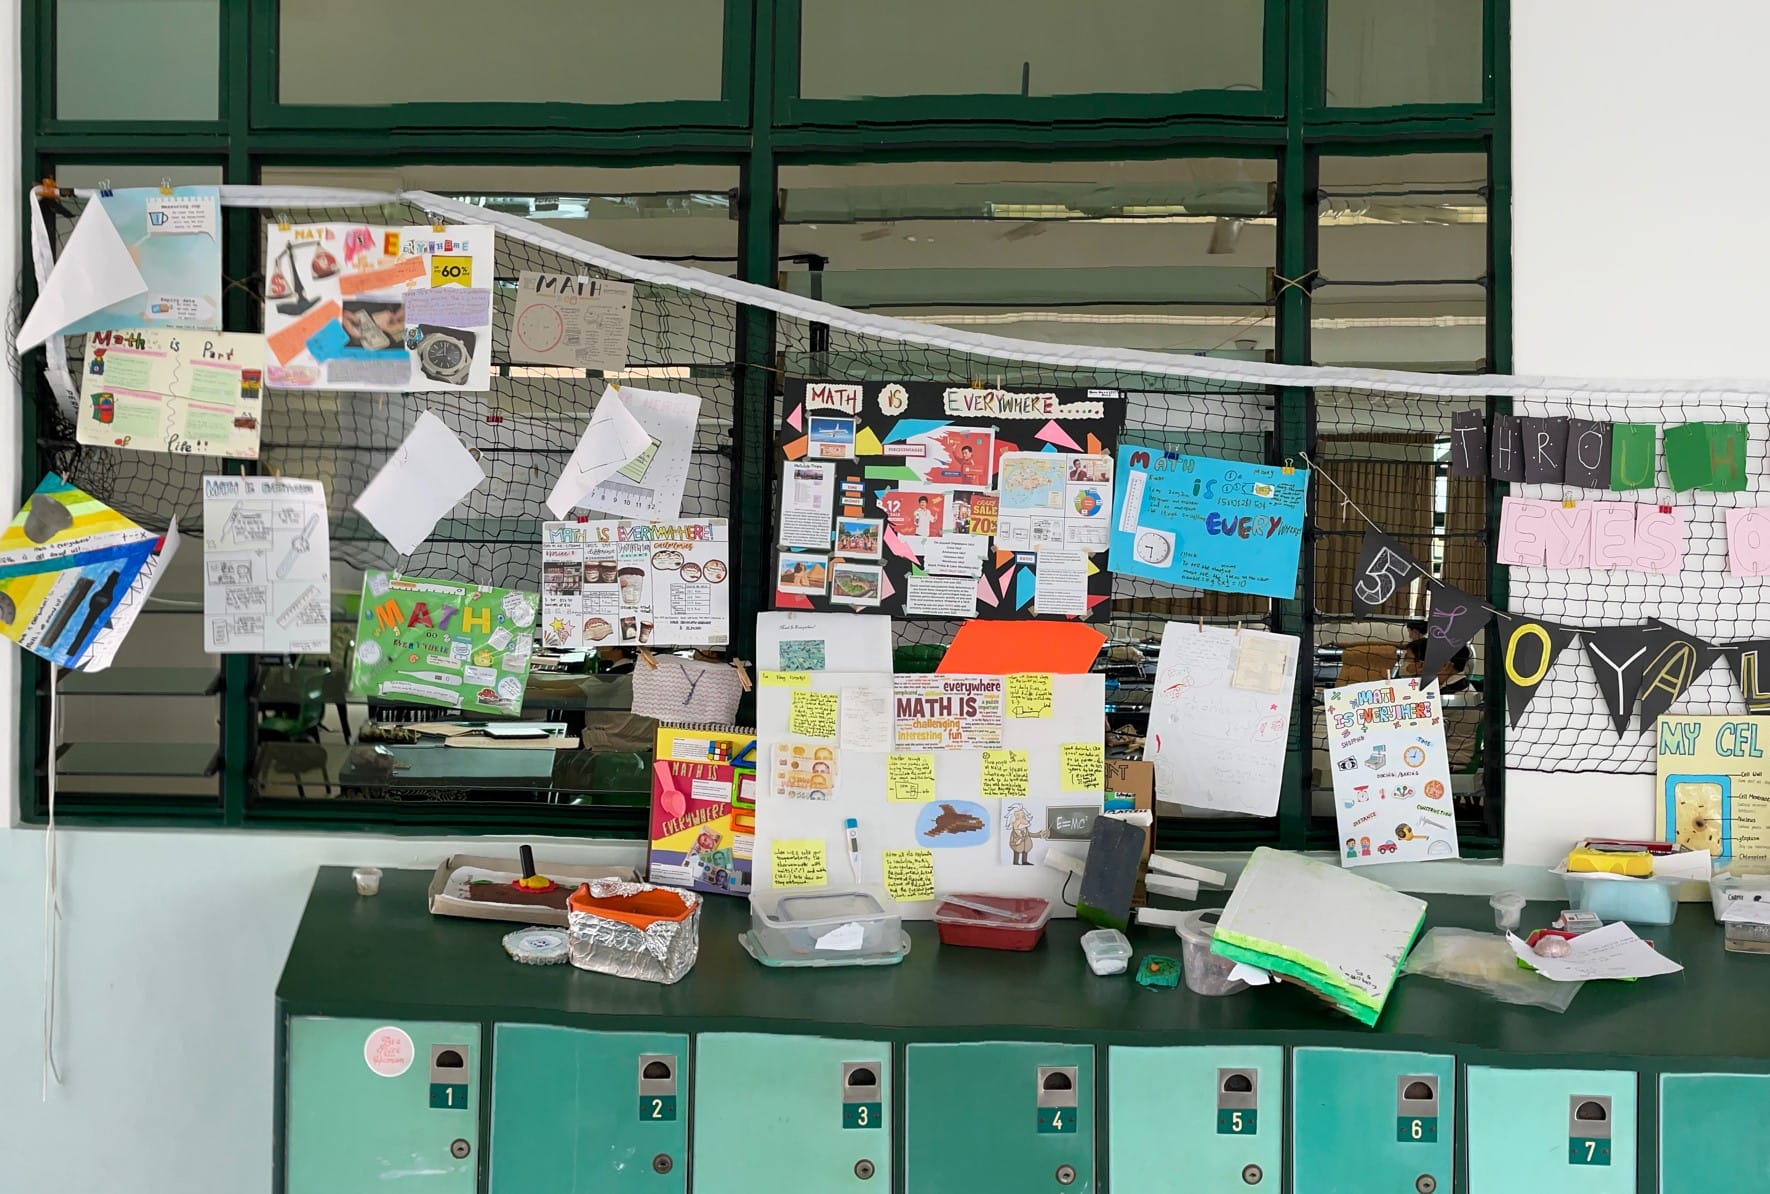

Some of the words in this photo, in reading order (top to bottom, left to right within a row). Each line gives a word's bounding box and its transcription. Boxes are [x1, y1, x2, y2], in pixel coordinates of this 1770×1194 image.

[92, 330, 146, 350] Math
[811, 388, 857, 415] MATH
[1130, 451, 1195, 473] MATH
[1454, 426, 1738, 487] THROUH
[973, 506, 997, 515] SALE
[549, 527, 587, 543] MATH
[596, 527, 610, 543] IS
[1502, 504, 1677, 572] EYES
[1355, 546, 1412, 605] 5
[375, 598, 491, 633] MATH
[943, 679, 1001, 696] everywhere
[896, 697, 952, 718] MATH
[959, 697, 977, 718] IS
[912, 718, 961, 732] challenging
[1333, 712, 1354, 729] IS
[898, 730, 943, 743] interesting
[948, 729, 962, 740] fun
[1659, 721, 1702, 756] MY
[672, 762, 704, 779] MATH
[707, 765, 719, 781] IS
[661, 803, 726, 837] EVERYWHERE
[446, 1087, 452, 1106] 1
[652, 1099, 662, 1118] 2
[858, 1106, 868, 1126] 3
[1052, 1111, 1063, 1130] 4
[1232, 1112, 1242, 1132] 5
[1411, 1119, 1422, 1139] 6
[1585, 1141, 1596, 1162] 7
